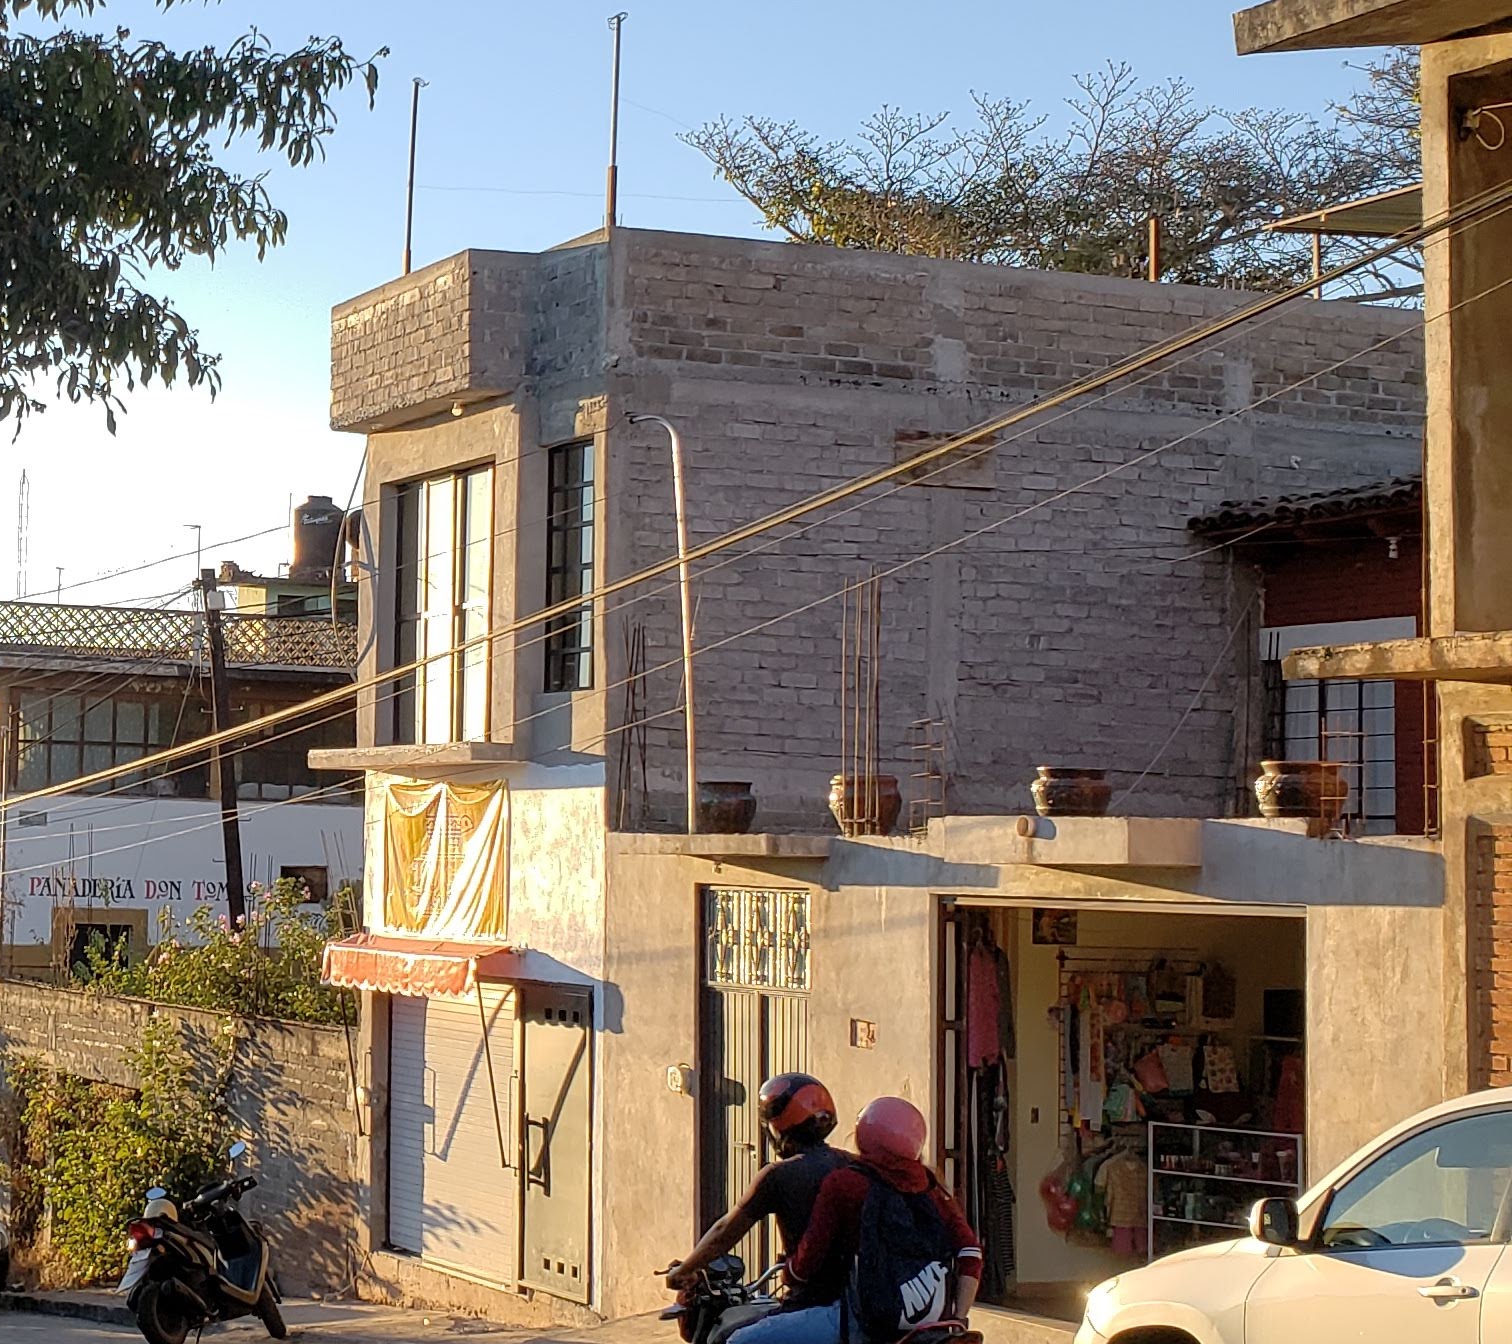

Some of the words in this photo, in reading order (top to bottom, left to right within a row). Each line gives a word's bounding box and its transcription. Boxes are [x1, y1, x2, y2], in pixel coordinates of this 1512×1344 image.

[29, 876, 136, 903] PANADERÍA
[144, 879, 182, 901] DON
[900, 1260, 947, 1319] NIKE
